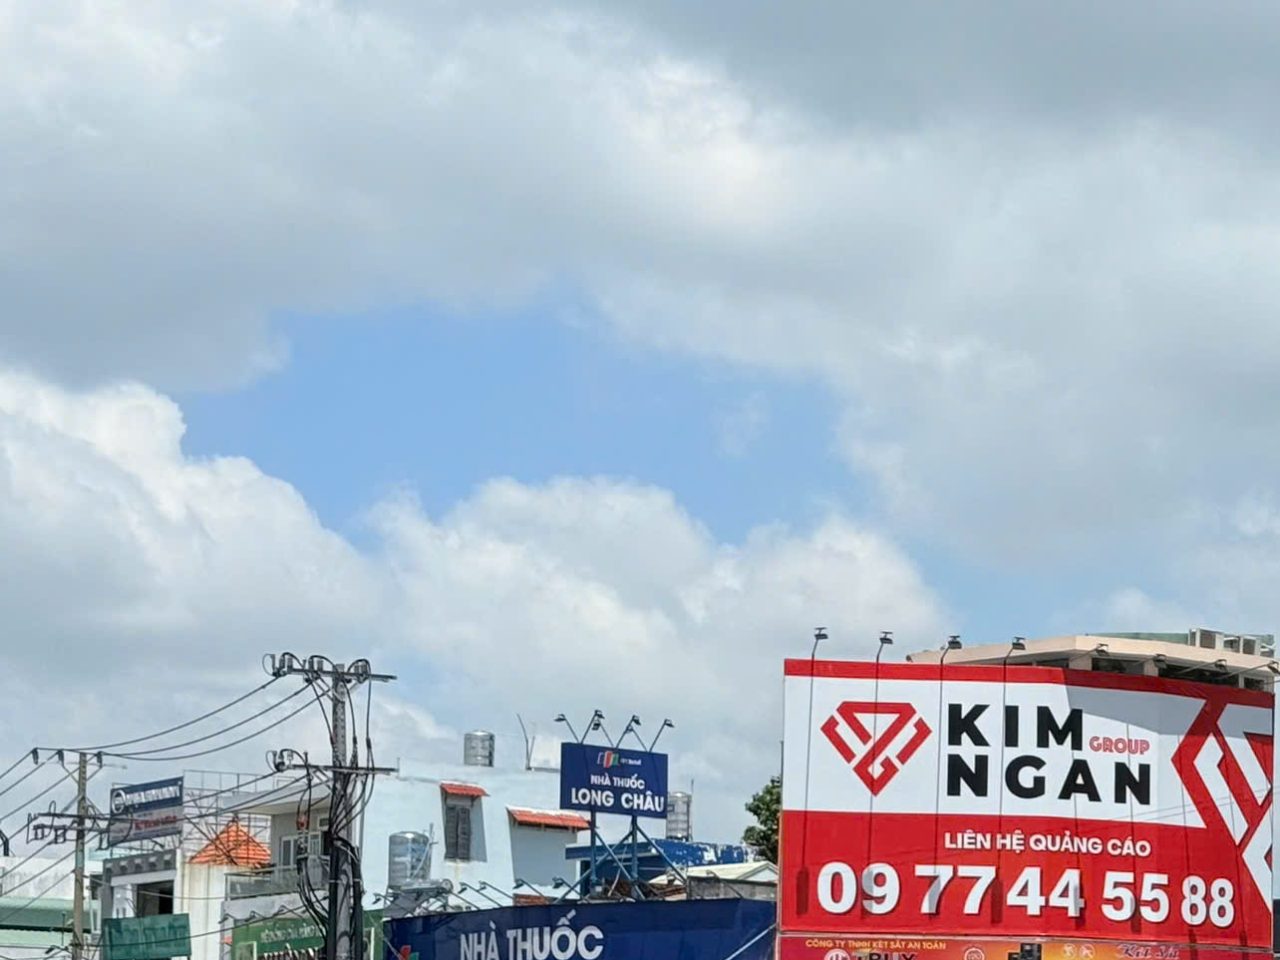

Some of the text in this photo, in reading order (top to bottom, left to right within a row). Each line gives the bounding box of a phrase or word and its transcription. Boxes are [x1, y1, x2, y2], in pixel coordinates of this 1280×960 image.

[948, 703, 1083, 751] KIM
[1089, 736, 1150, 755] GROUP
[590, 772, 645, 789] NHÀ THUỐC
[947, 753, 1150, 805] NGAN
[571, 787, 664, 812] LONG CHÂU
[944, 829, 1151, 857] LIÊN HỆ QUẢNG CÁO
[816, 861, 1235, 928] 09 77 44 55 88
[805, 939, 833, 948] CÔNG
[907, 941, 921, 949] AN
